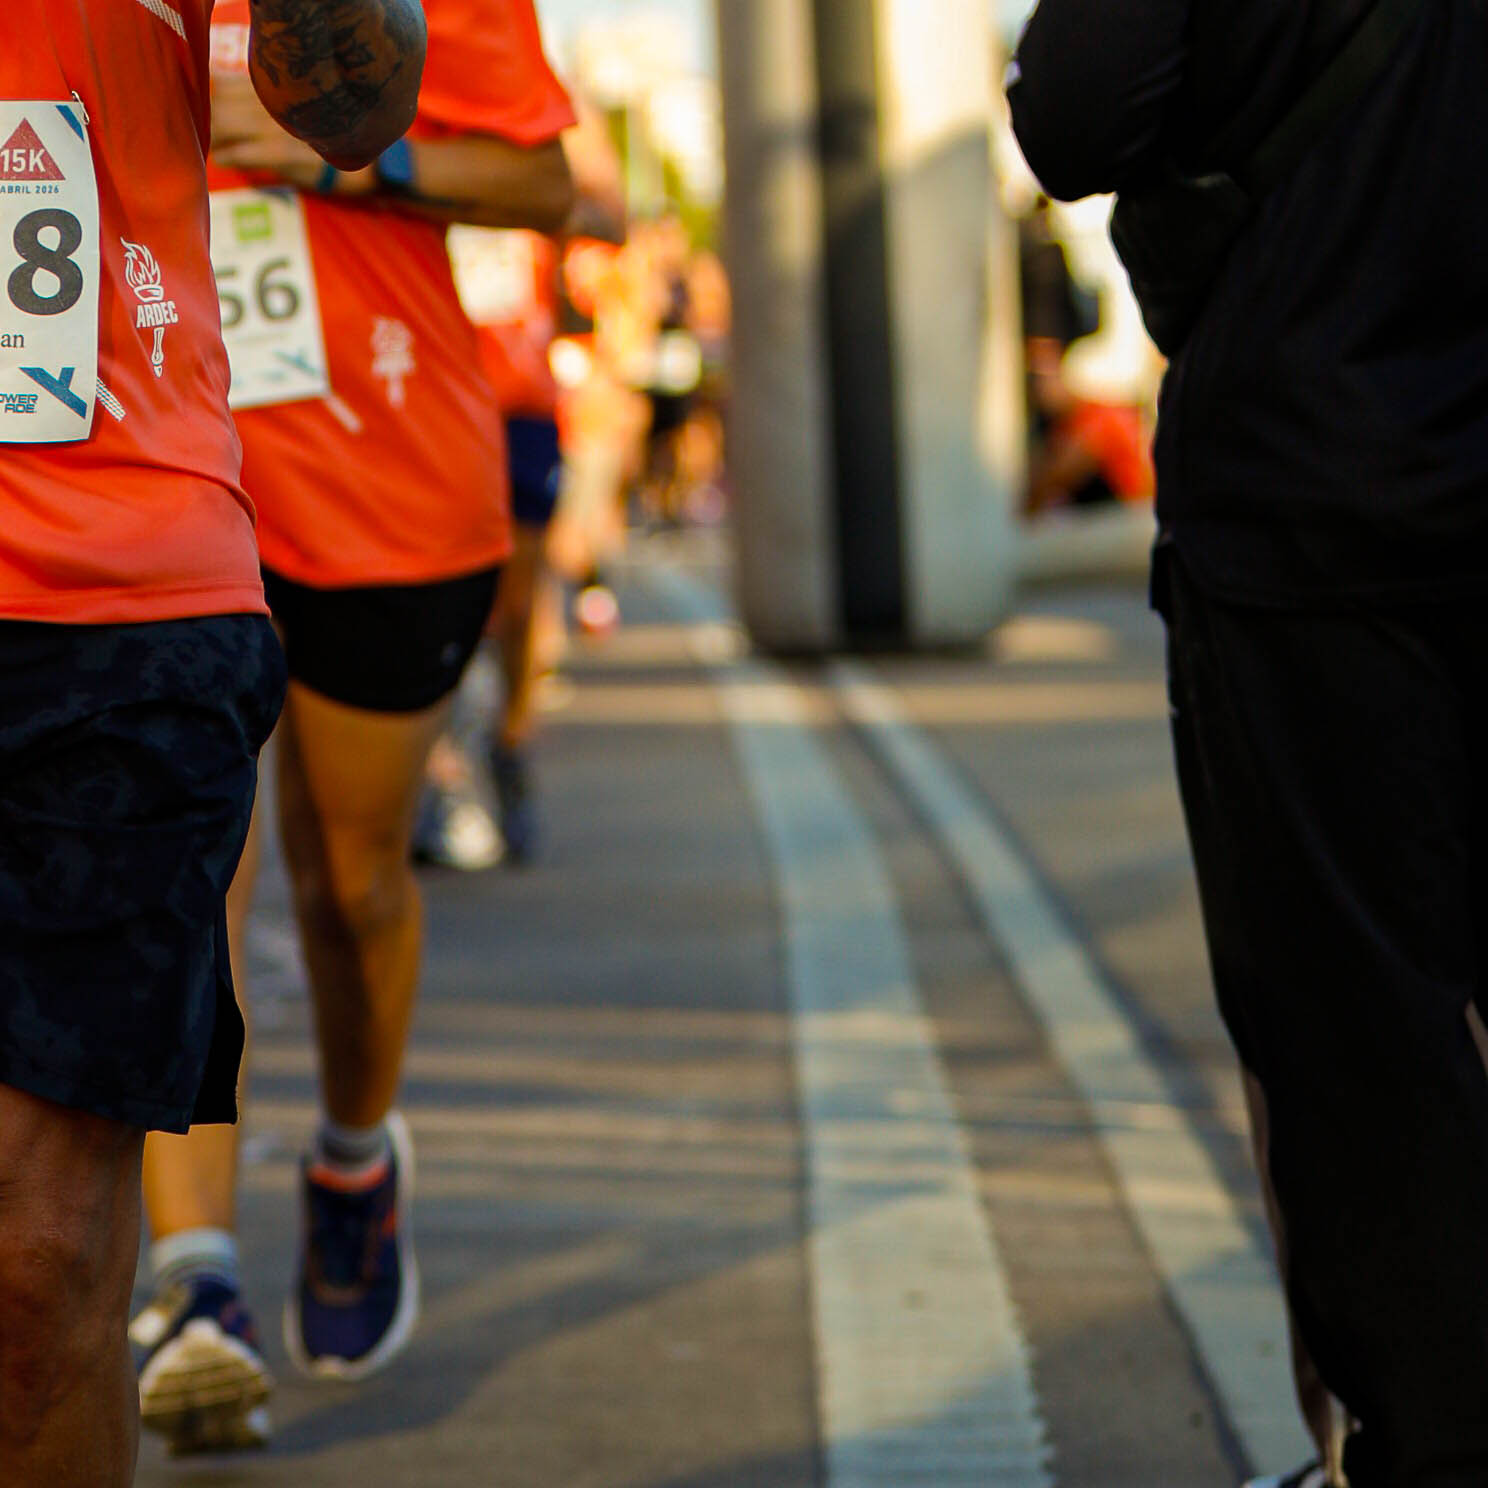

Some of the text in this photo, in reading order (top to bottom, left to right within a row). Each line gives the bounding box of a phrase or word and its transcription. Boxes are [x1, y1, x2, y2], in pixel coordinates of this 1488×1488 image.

[0, 148, 47, 174] 15K
[0, 183, 31, 194] ABRIL
[35, 183, 60, 194] 2026
[136, 301, 178, 328] ARDEC
